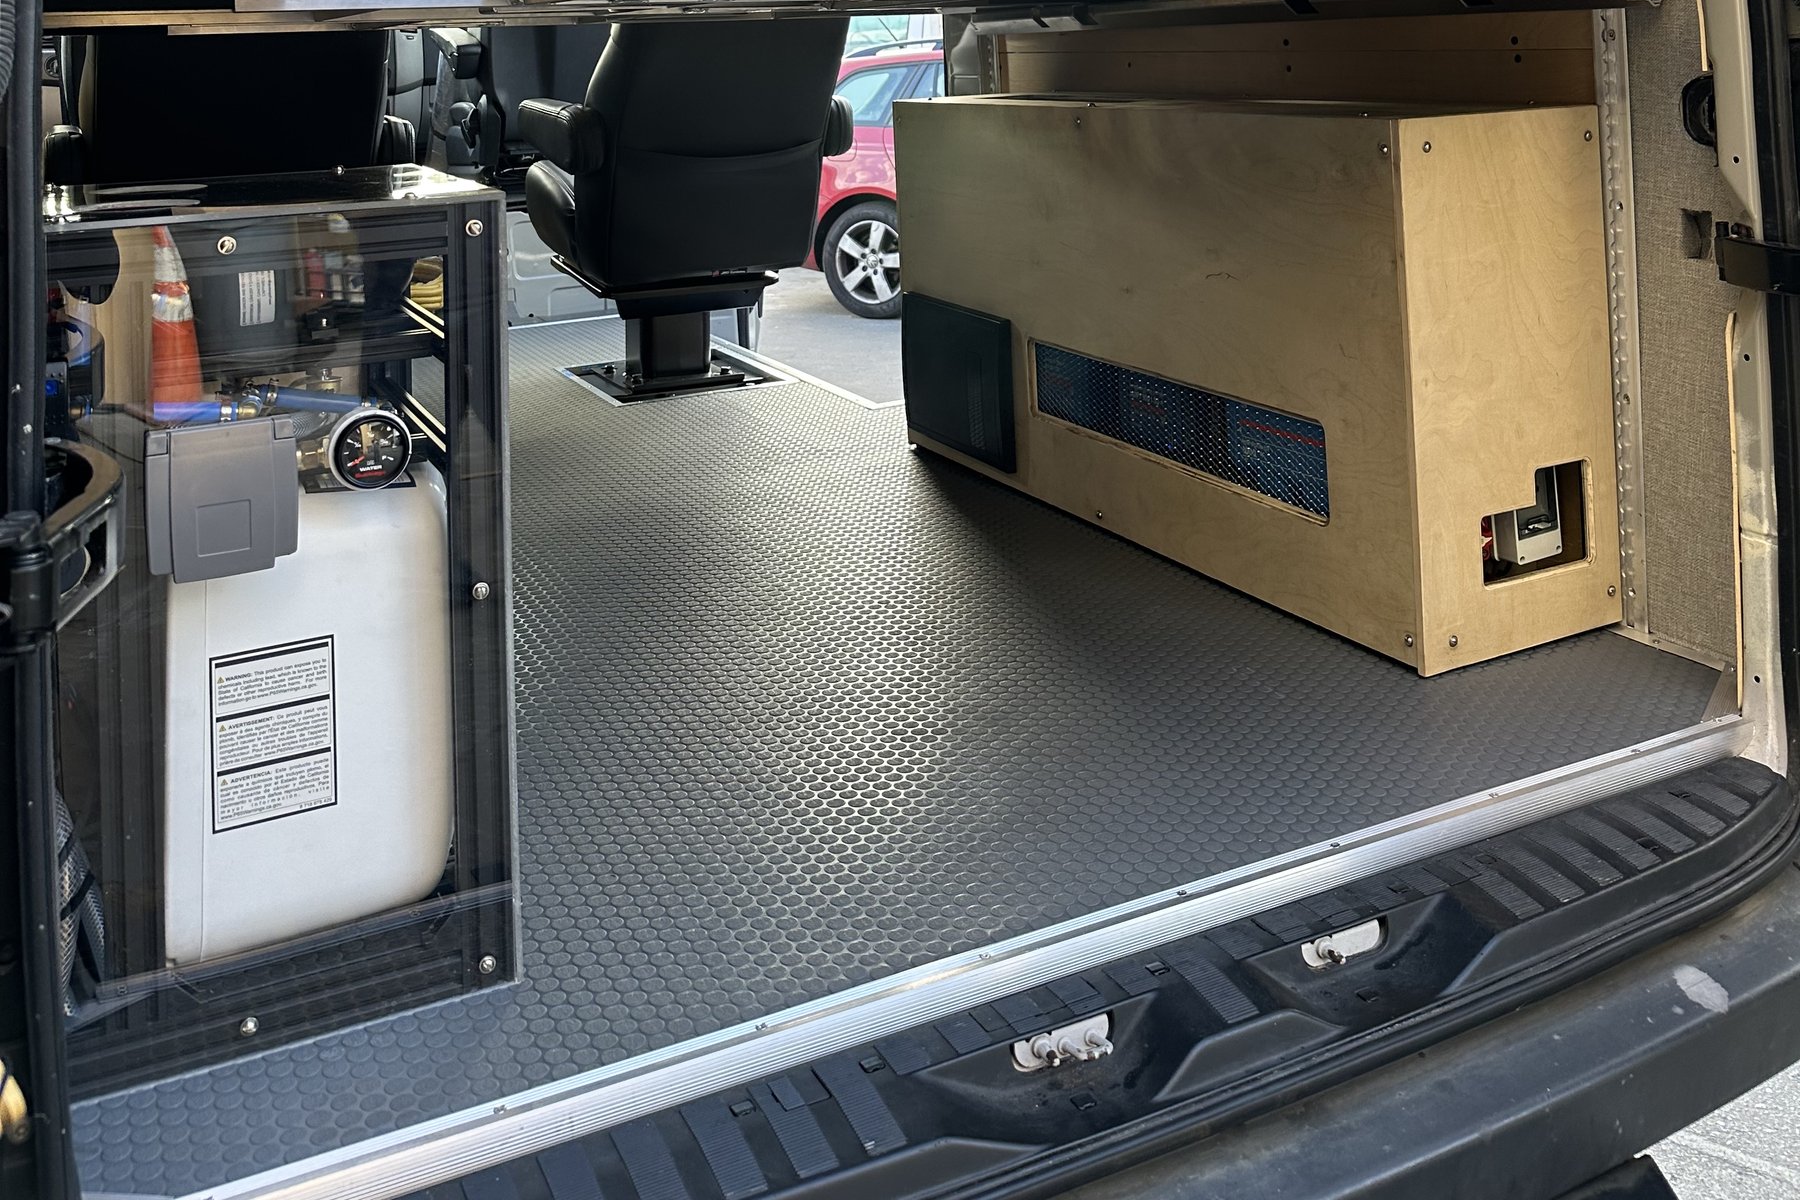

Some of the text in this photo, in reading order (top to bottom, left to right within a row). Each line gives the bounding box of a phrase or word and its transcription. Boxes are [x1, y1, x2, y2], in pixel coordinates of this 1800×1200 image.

[359, 464, 383, 472] WATER
[225, 673, 253, 682] WARNING:
[265, 667, 283, 675] product
[218, 681, 242, 690] chemicals
[243, 677, 264, 686] including
[240, 683, 262, 691] California
[258, 683, 287, 694] reproductive
[218, 697, 245, 706] information
[228, 716, 275, 729] AVERTISSEMENT:
[286, 710, 302, 718] produit
[219, 731, 238, 739] exposer
[303, 713, 320, 721] compris
[296, 722, 328, 732] malformations
[231, 770, 272, 783] ADVERTENCIA:
[289, 761, 311, 771] producto
[314, 757, 329, 766] puede
[307, 769, 329, 778] California
